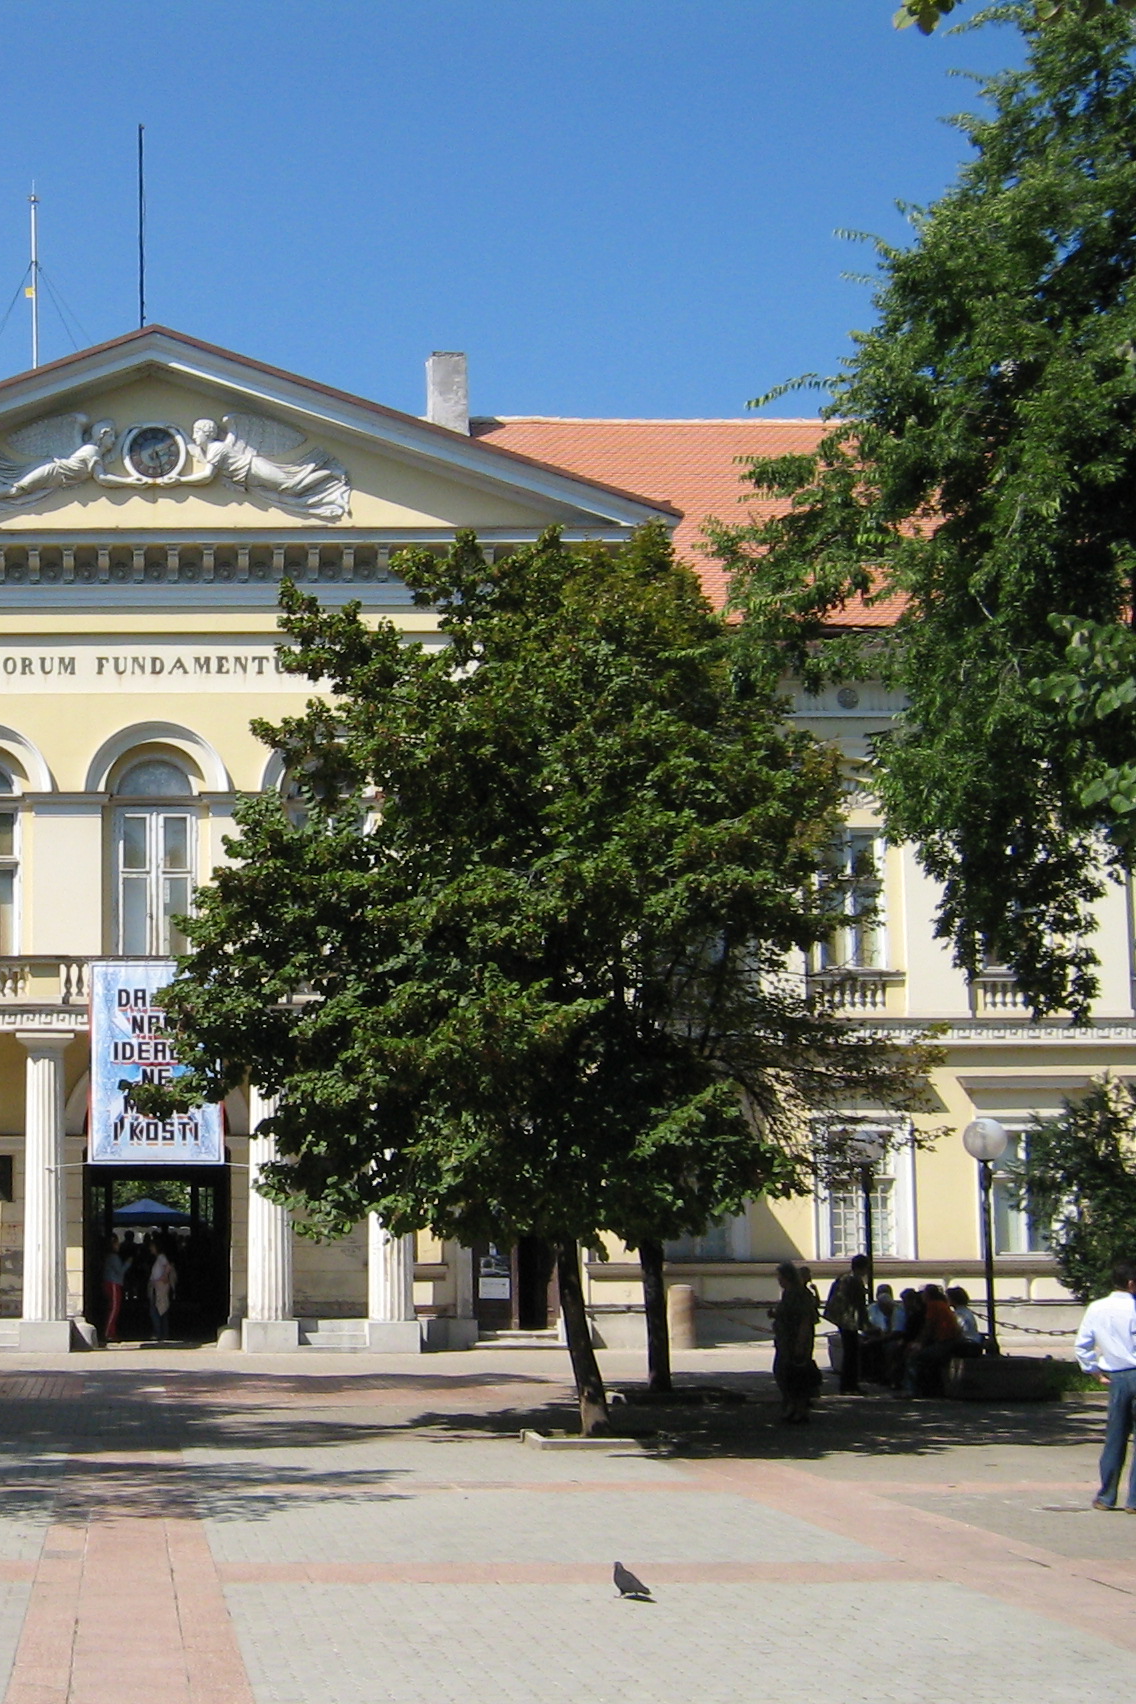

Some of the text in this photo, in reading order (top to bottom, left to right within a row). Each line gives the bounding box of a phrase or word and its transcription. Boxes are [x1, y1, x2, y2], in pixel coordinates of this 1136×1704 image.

[95, 656, 287, 675] FUNDAMENTU
[113, 1041, 179, 1061] IDEAL
[113, 1121, 199, 1141] I KOSTI
